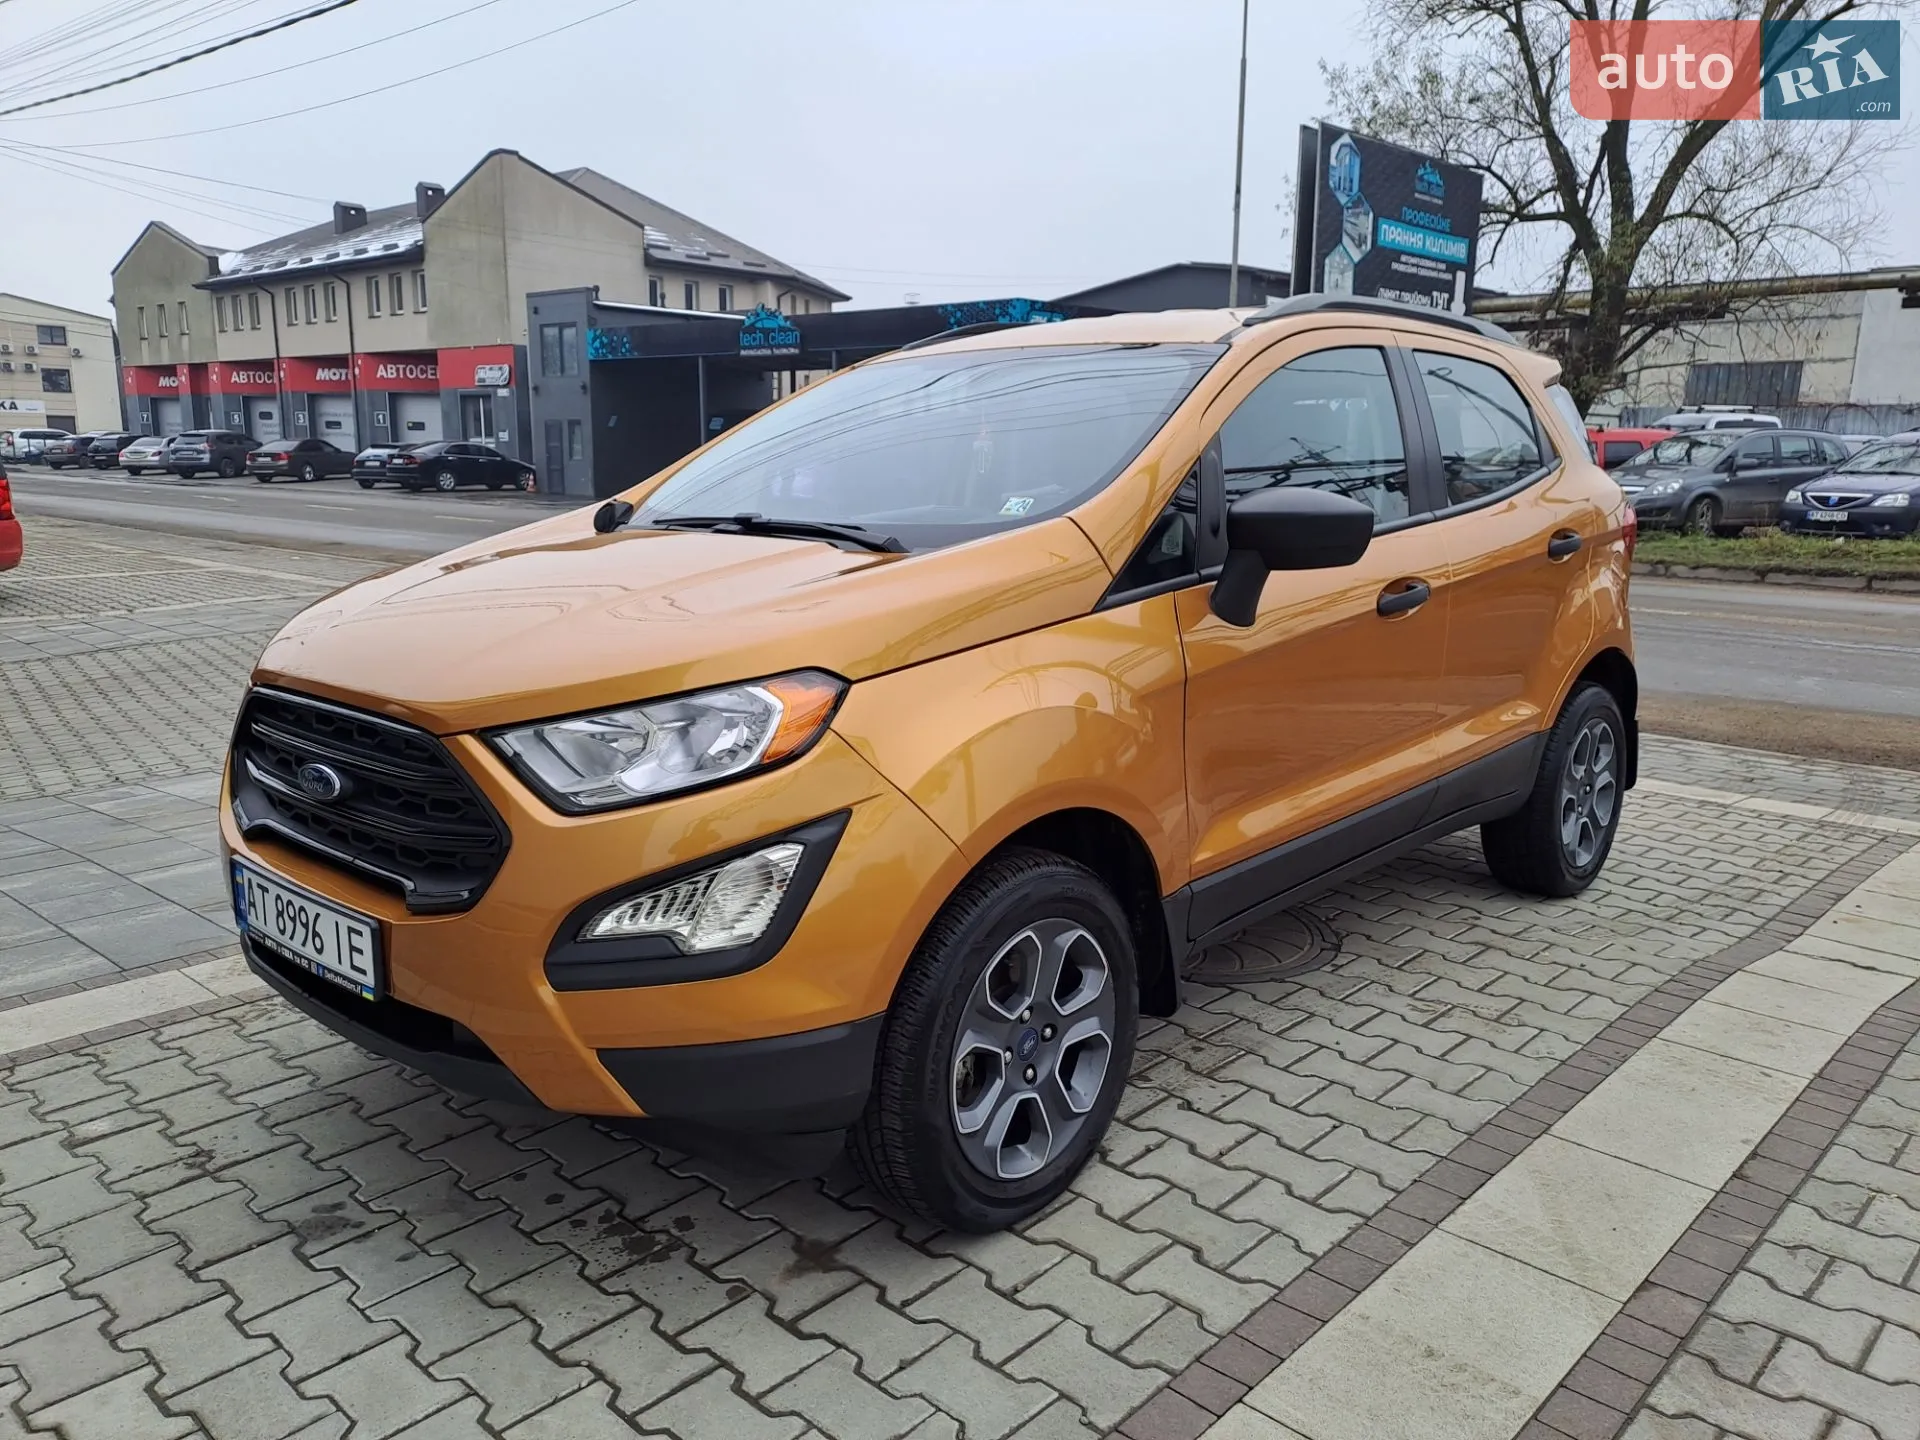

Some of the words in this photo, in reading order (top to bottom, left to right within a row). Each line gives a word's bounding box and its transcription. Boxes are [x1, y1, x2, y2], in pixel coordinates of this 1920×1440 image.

[1381, 224, 1423, 249] ПРАННЯ
[1425, 235, 1466, 258] КИЛИМІВ
[769, 328, 800, 345] clean
[297, 414, 304, 424] 3
[247, 877, 269, 927] AT
[274, 893, 324, 956] 8996
[335, 920, 367, 977] IE
